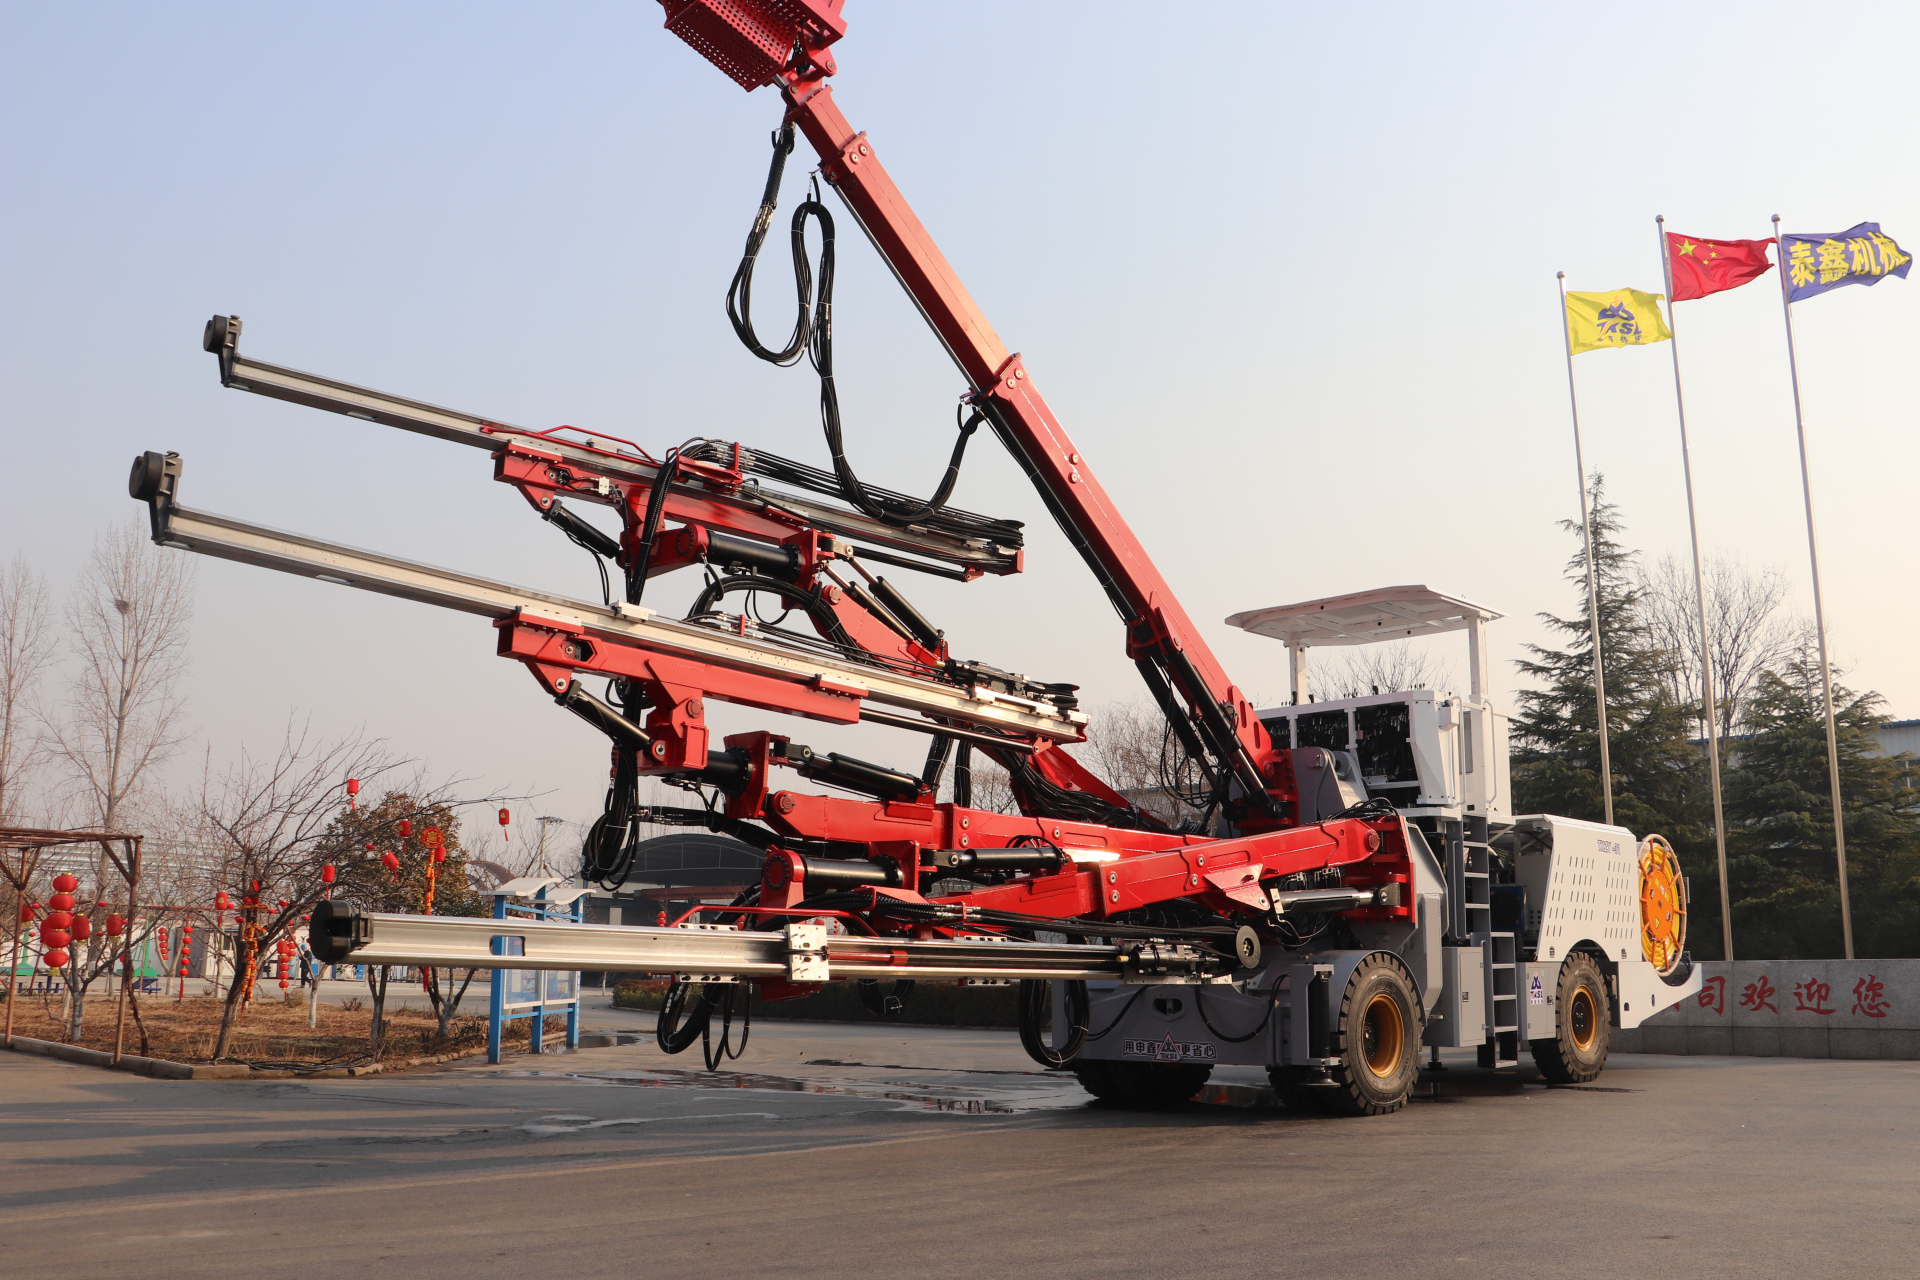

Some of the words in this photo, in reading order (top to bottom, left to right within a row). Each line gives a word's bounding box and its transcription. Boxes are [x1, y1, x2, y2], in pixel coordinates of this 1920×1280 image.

[1789, 231, 1911, 288] 泰鑫机械
[1671, 974, 1891, 1018] 司欢迎您
[1181, 1044, 1215, 1058] 更省心
